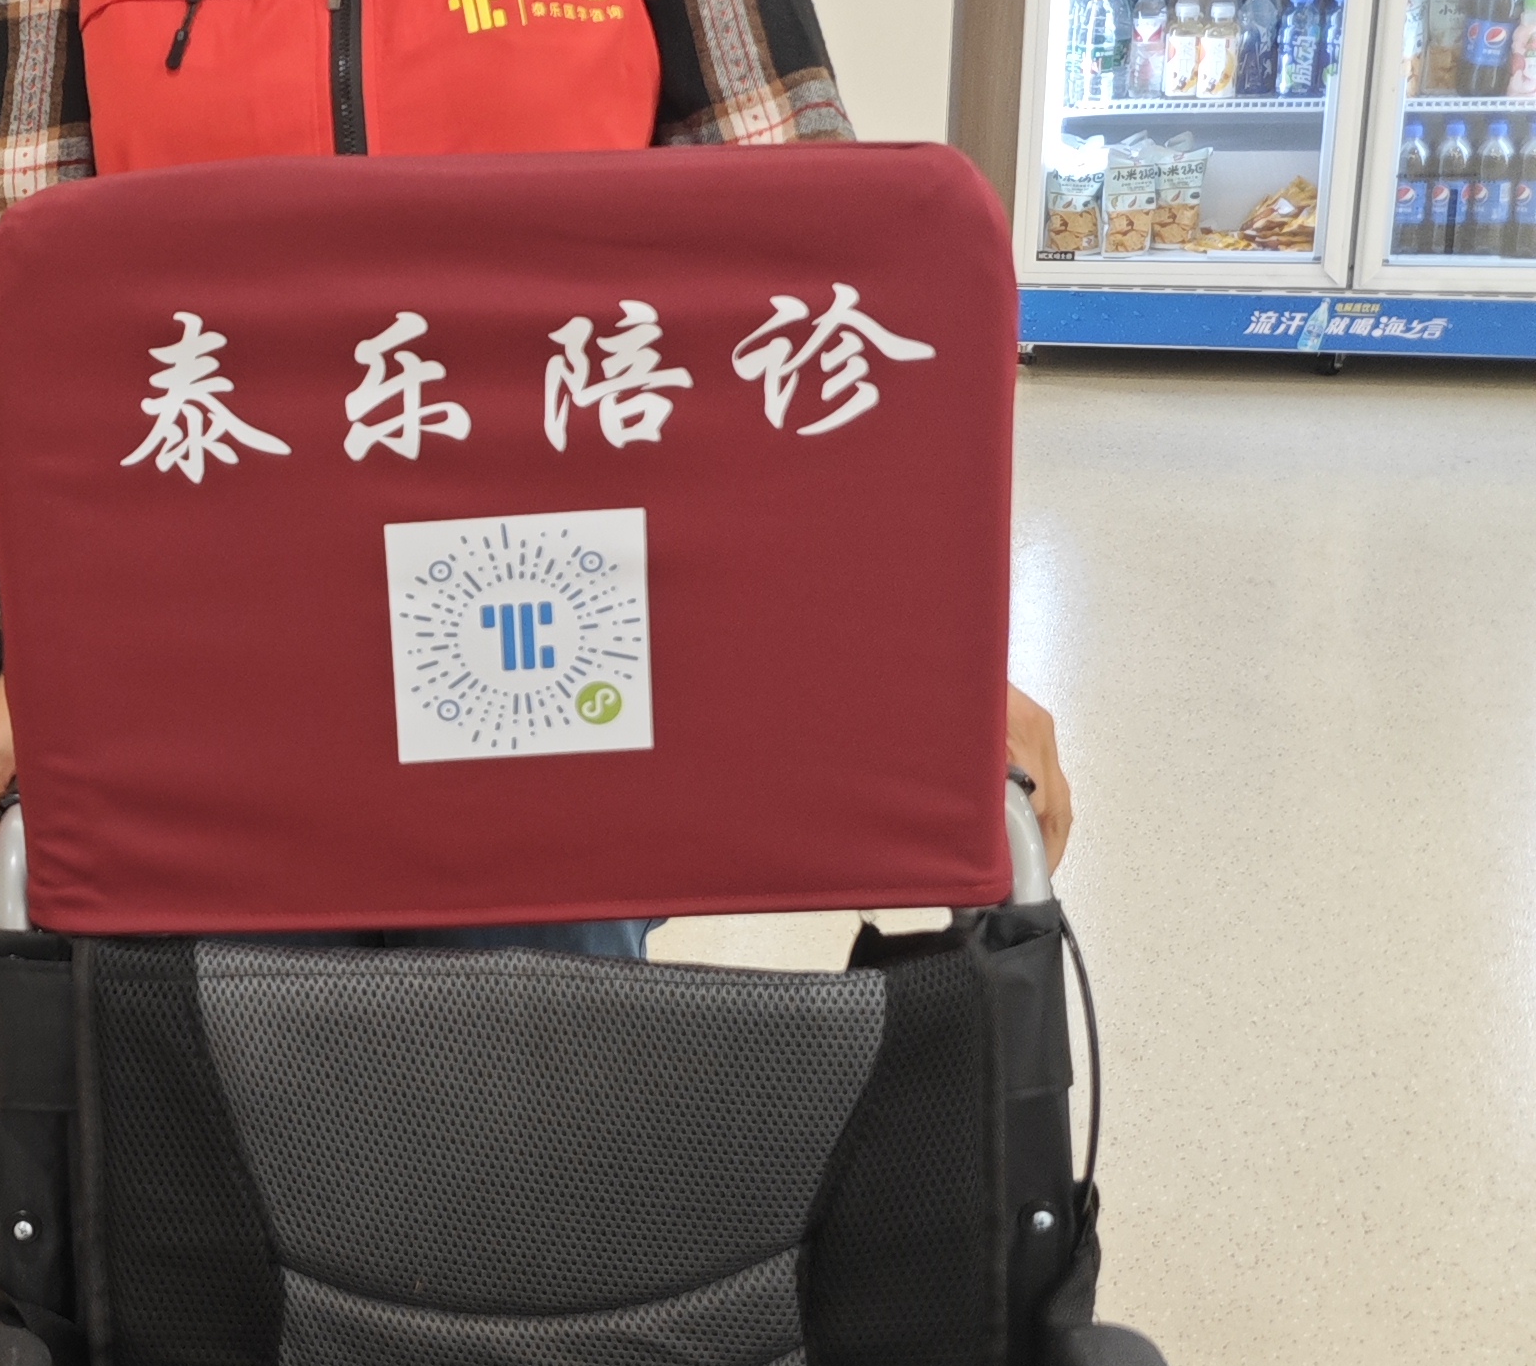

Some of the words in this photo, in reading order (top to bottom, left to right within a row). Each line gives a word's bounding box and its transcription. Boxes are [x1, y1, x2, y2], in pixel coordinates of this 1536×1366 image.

[1243, 310, 1308, 336] 流汗
[120, 283, 936, 484] 泰乐陪诊
